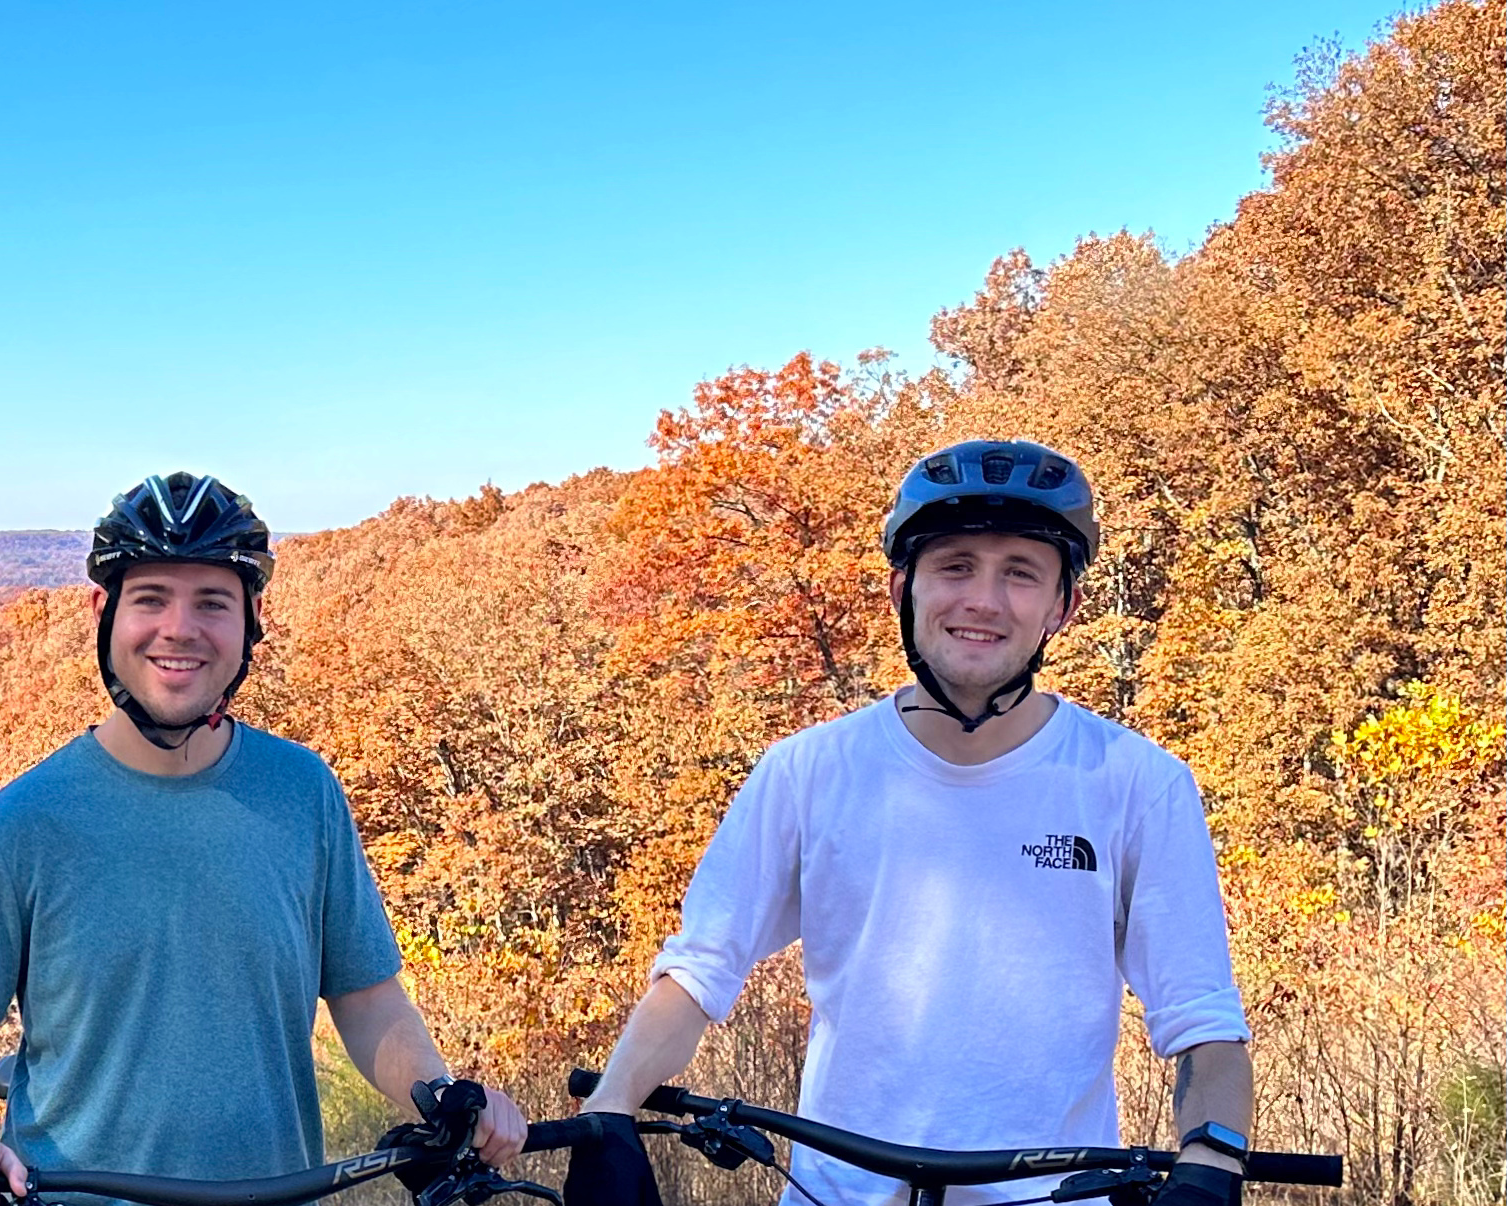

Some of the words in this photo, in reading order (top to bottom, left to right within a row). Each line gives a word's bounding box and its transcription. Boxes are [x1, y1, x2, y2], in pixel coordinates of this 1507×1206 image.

[1045, 834, 1073, 846] THE
[1021, 844, 1072, 857] NORTH
[1035, 857, 1071, 869] FACE
[1008, 1148, 1100, 1171] RSL
[332, 1148, 412, 1185] RSL
